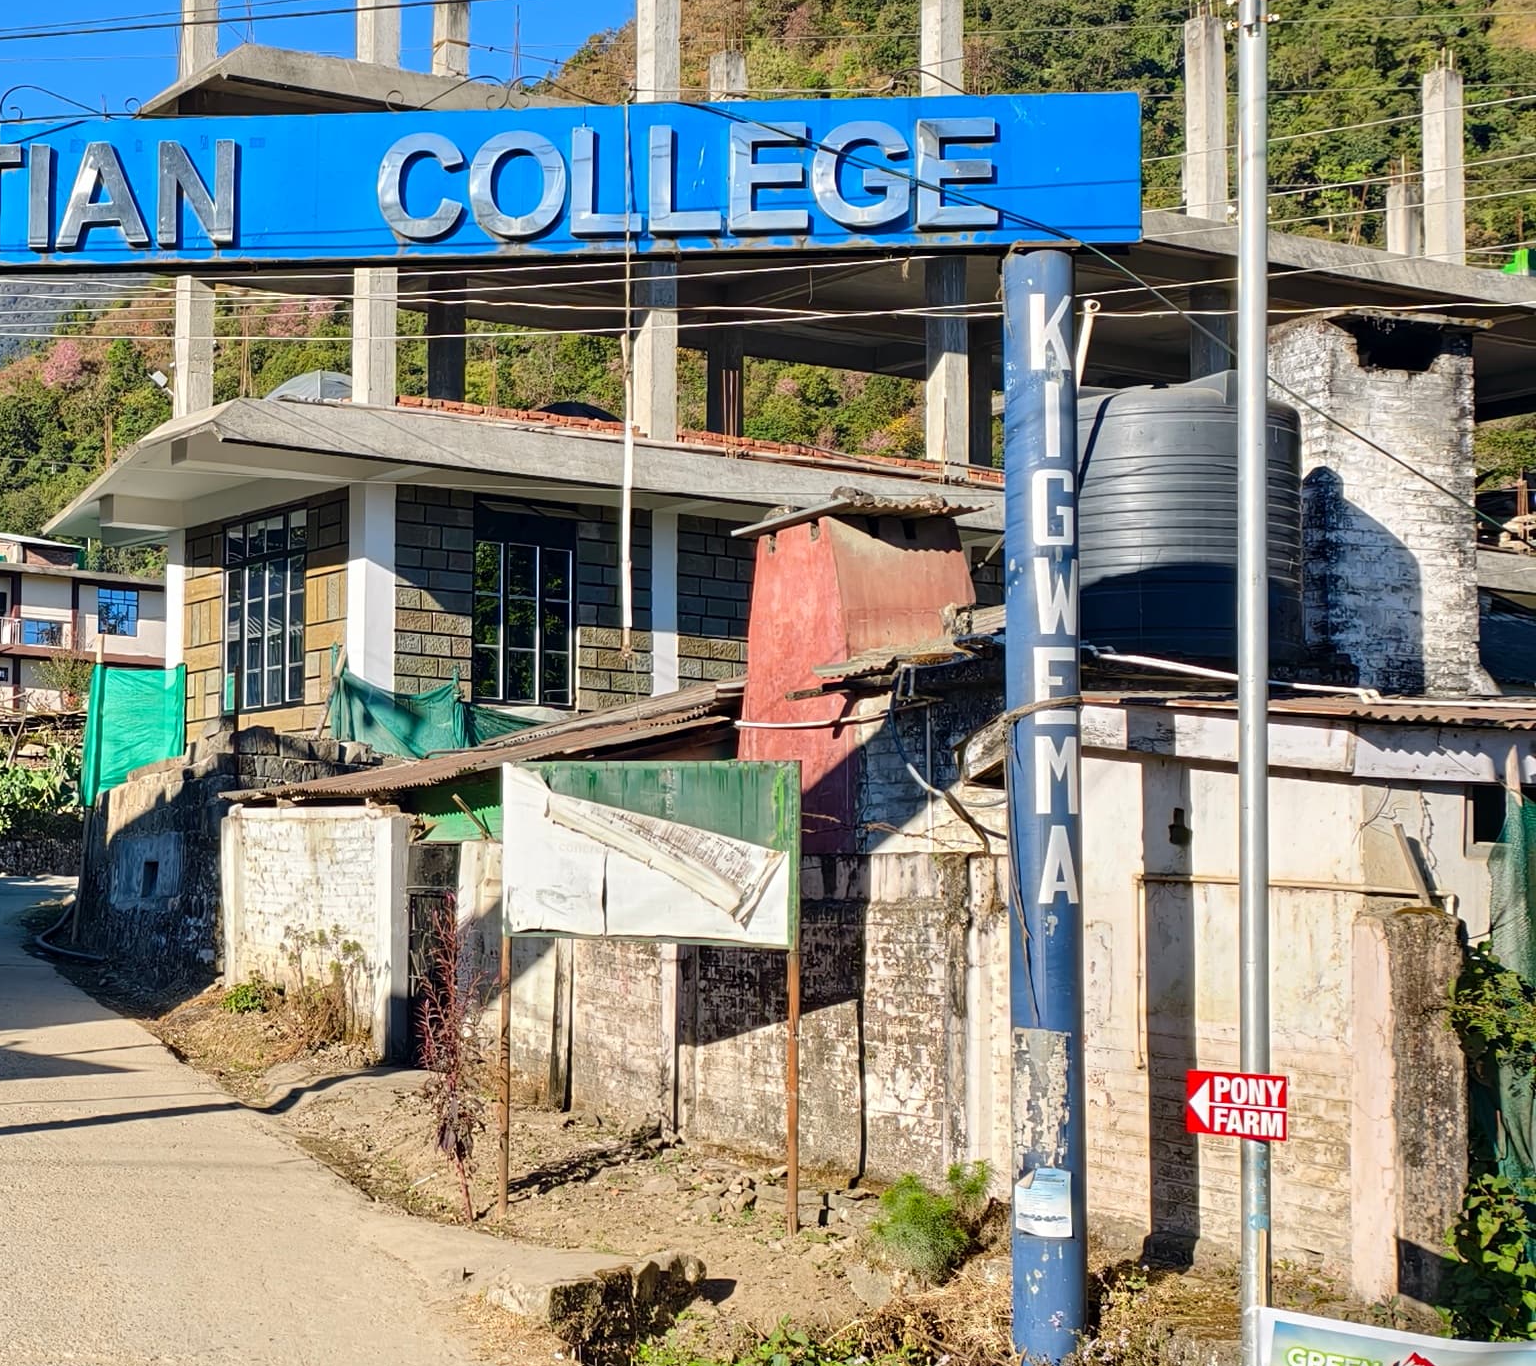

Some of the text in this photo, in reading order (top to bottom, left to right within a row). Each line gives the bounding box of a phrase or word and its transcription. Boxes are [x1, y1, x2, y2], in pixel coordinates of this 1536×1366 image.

[377, 117, 1000, 238] COLLEGE
[1028, 292, 1079, 904] KIGWEMA
[1214, 1075, 1283, 1107] PONY
[1214, 1107, 1284, 1139] FARM
